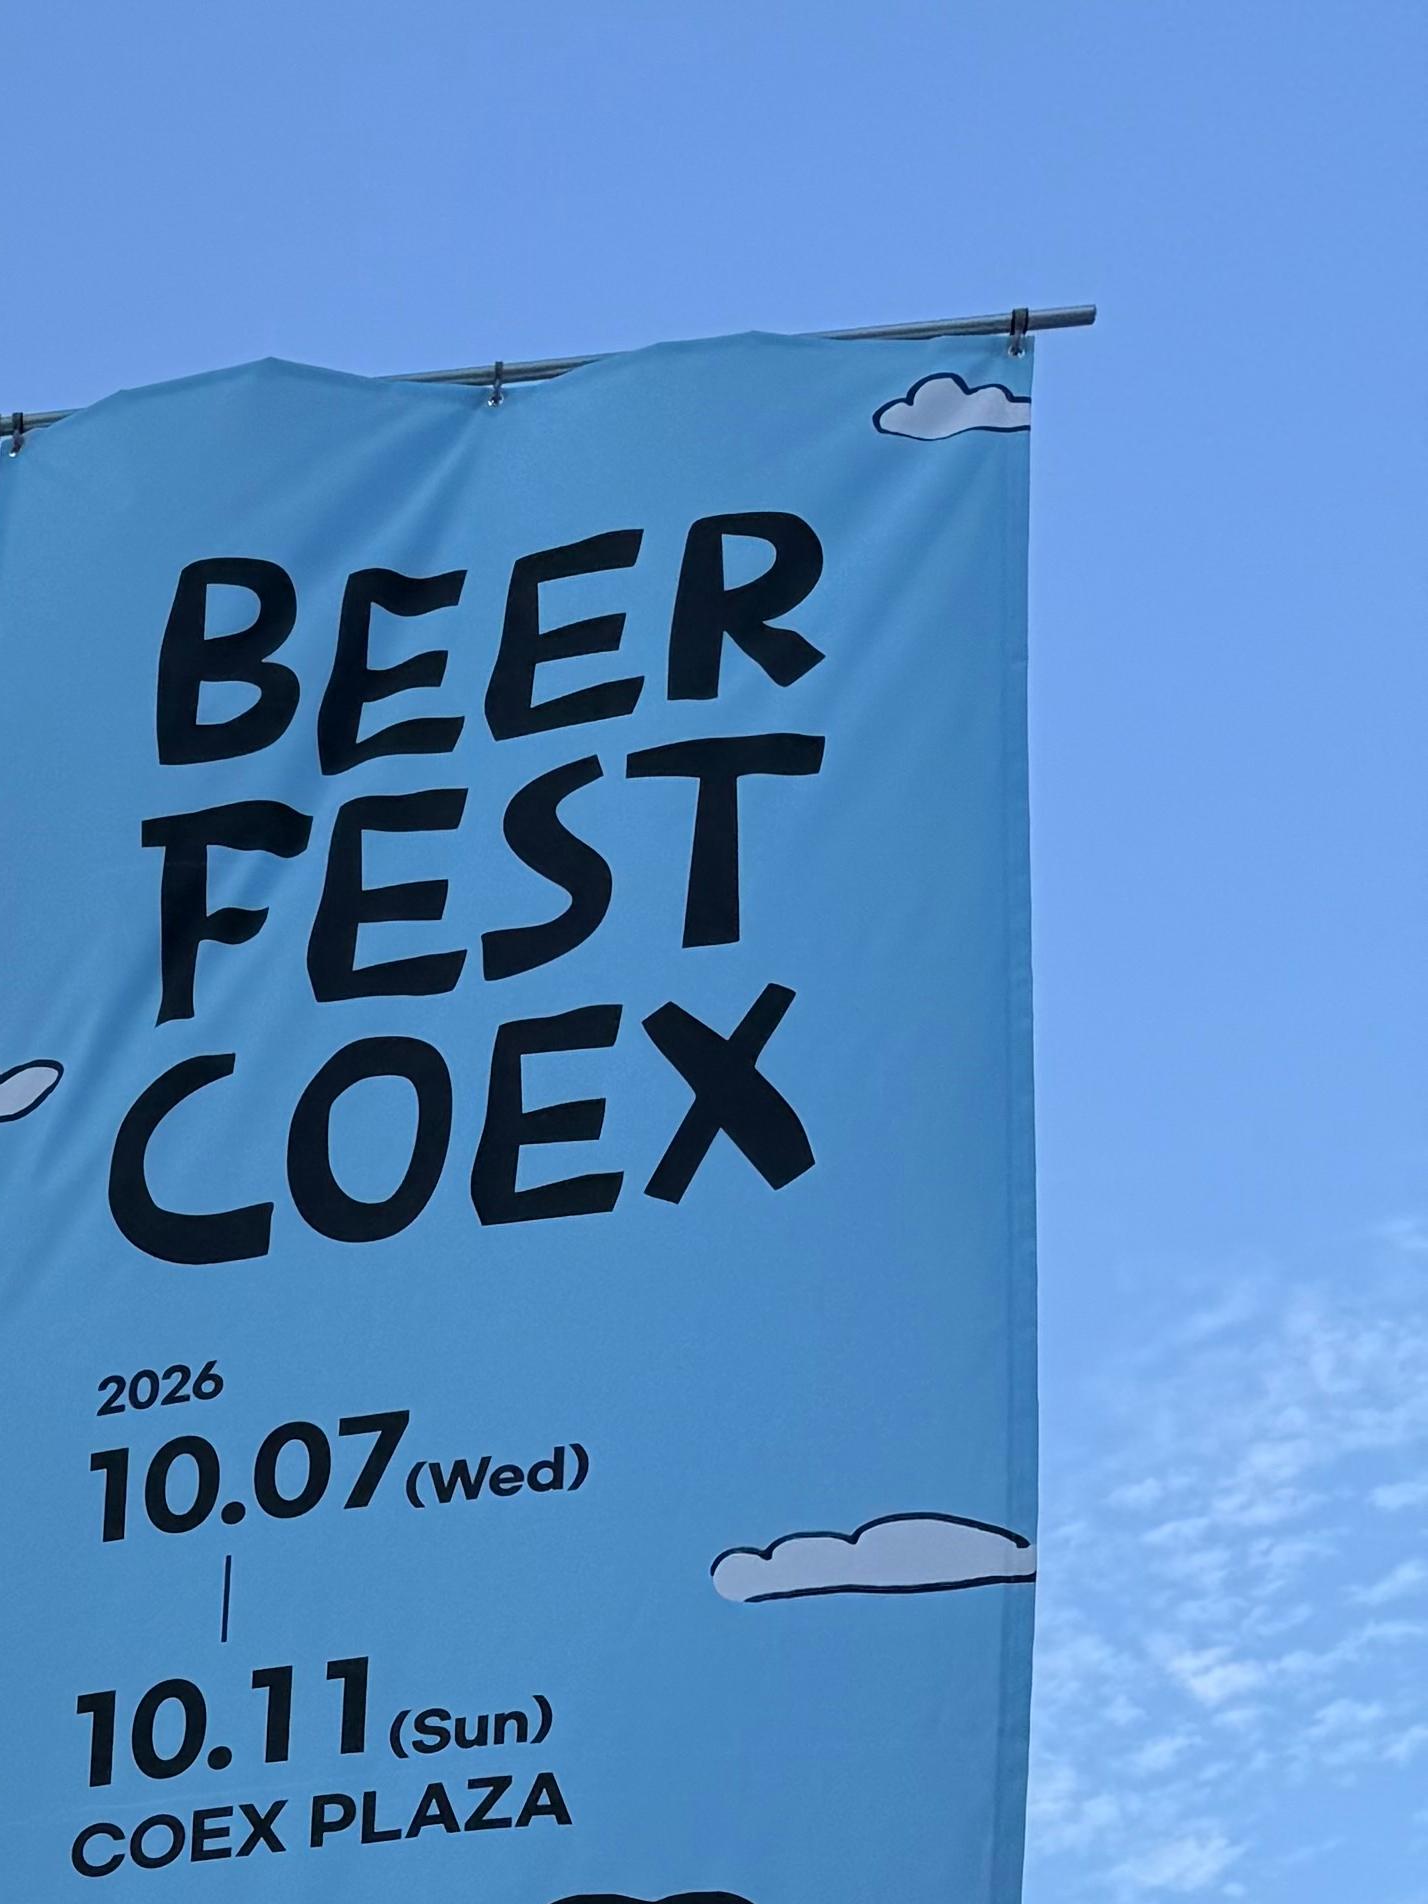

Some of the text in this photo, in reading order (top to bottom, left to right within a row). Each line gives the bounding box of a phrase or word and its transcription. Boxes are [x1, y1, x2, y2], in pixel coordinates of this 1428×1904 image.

[156, 511, 826, 776] BEER
[141, 733, 826, 1029] FEST
[108, 982, 816, 1266] COEX
[96, 1360, 224, 1417] 2026
[71, 1772, 572, 1878] COEX PLAZA
